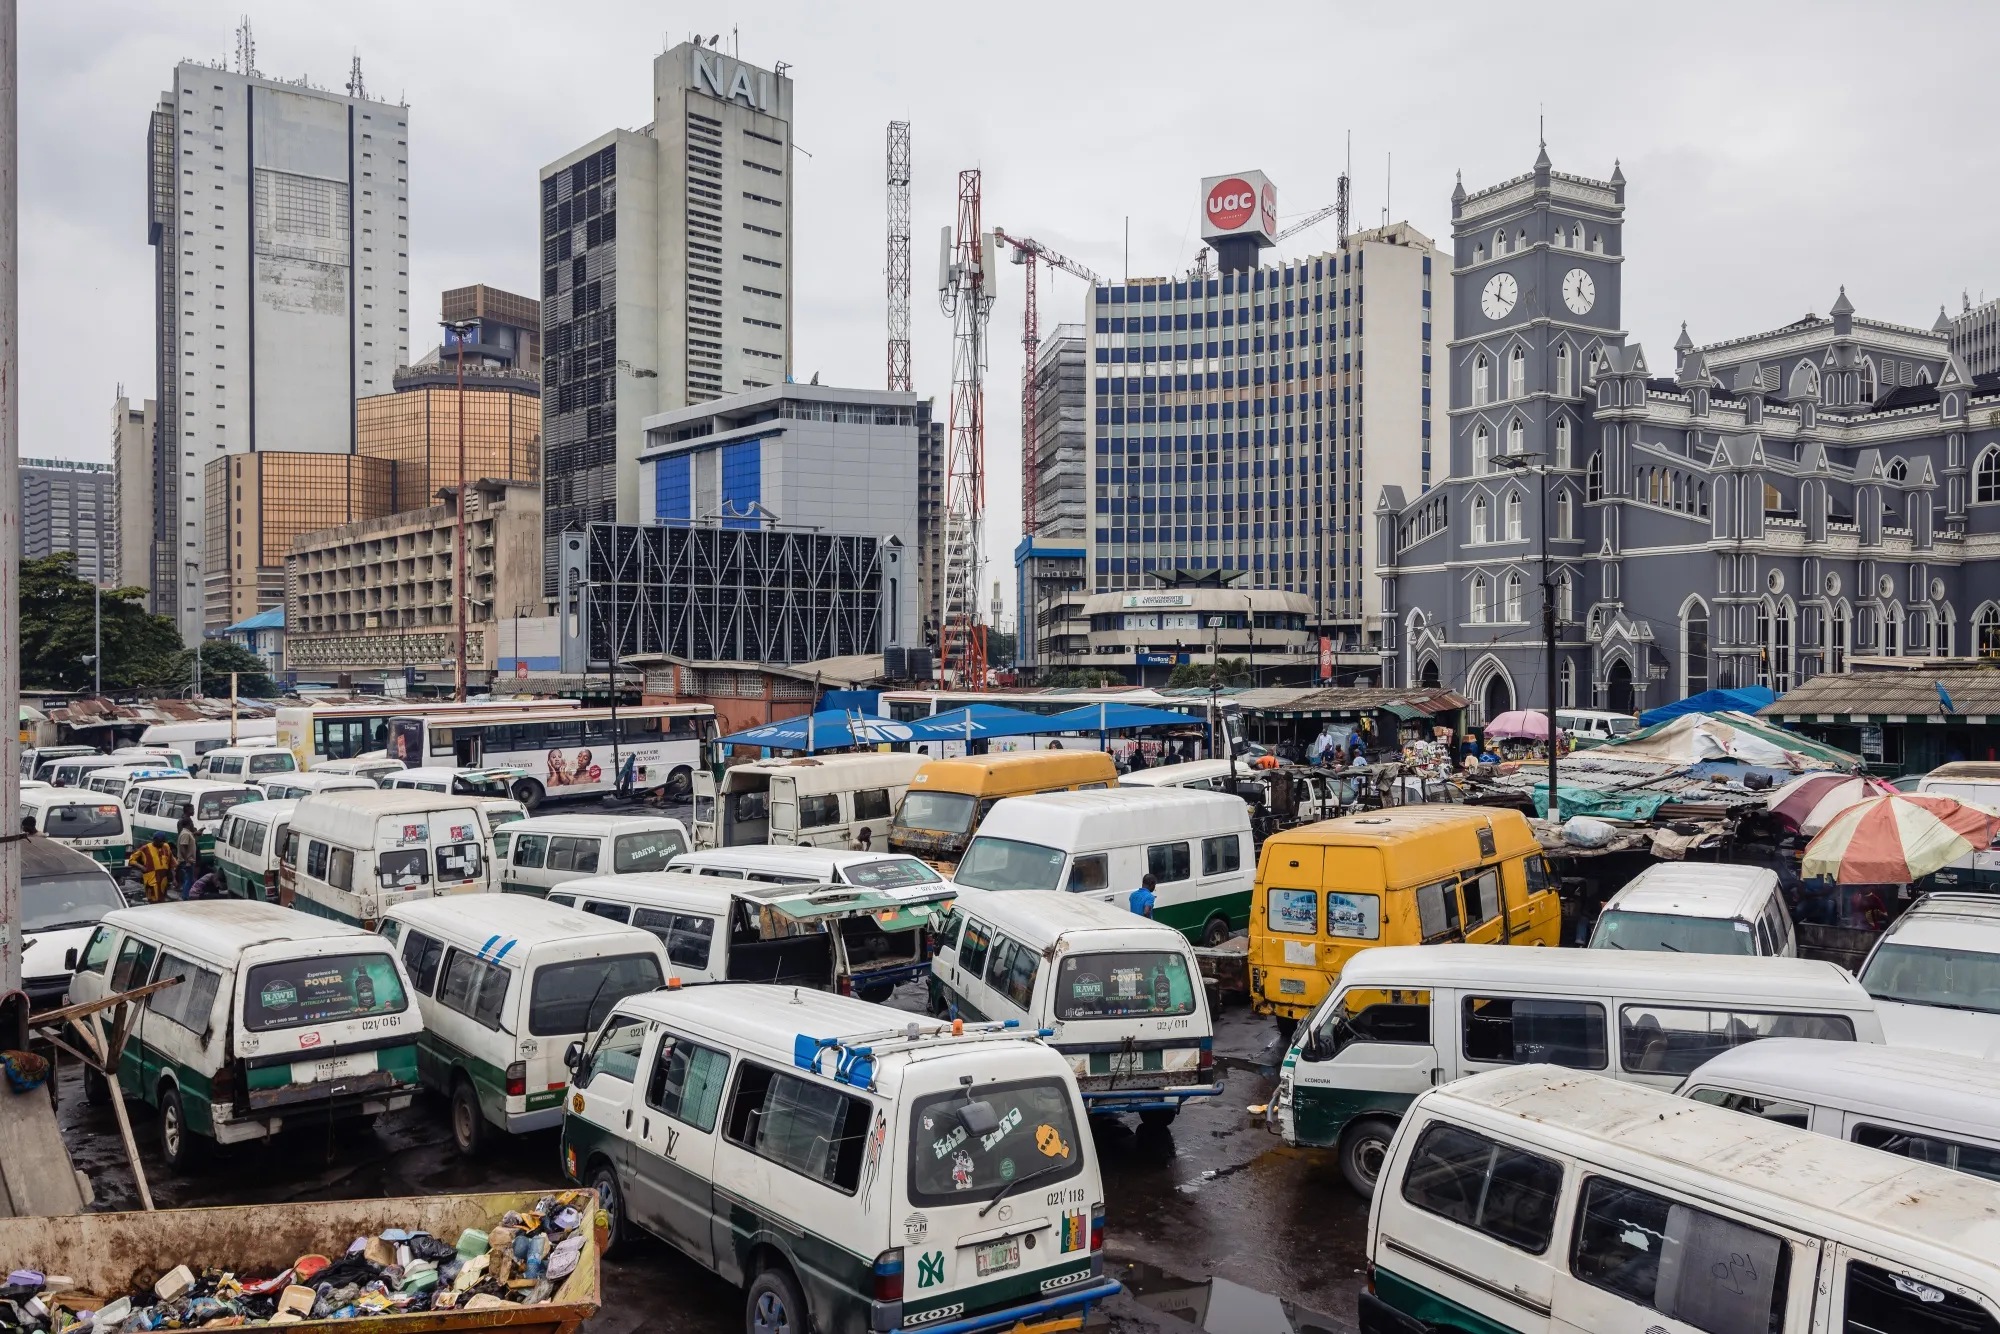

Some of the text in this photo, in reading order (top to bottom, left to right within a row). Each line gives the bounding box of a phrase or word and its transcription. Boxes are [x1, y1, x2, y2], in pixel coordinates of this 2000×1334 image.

[1209, 192, 1252, 214] uac
[304, 974, 344, 987] POWER
[1111, 973, 1143, 982] POWER
[1076, 984, 1100, 992] RAWH
[263, 990, 294, 1002] RAWH
